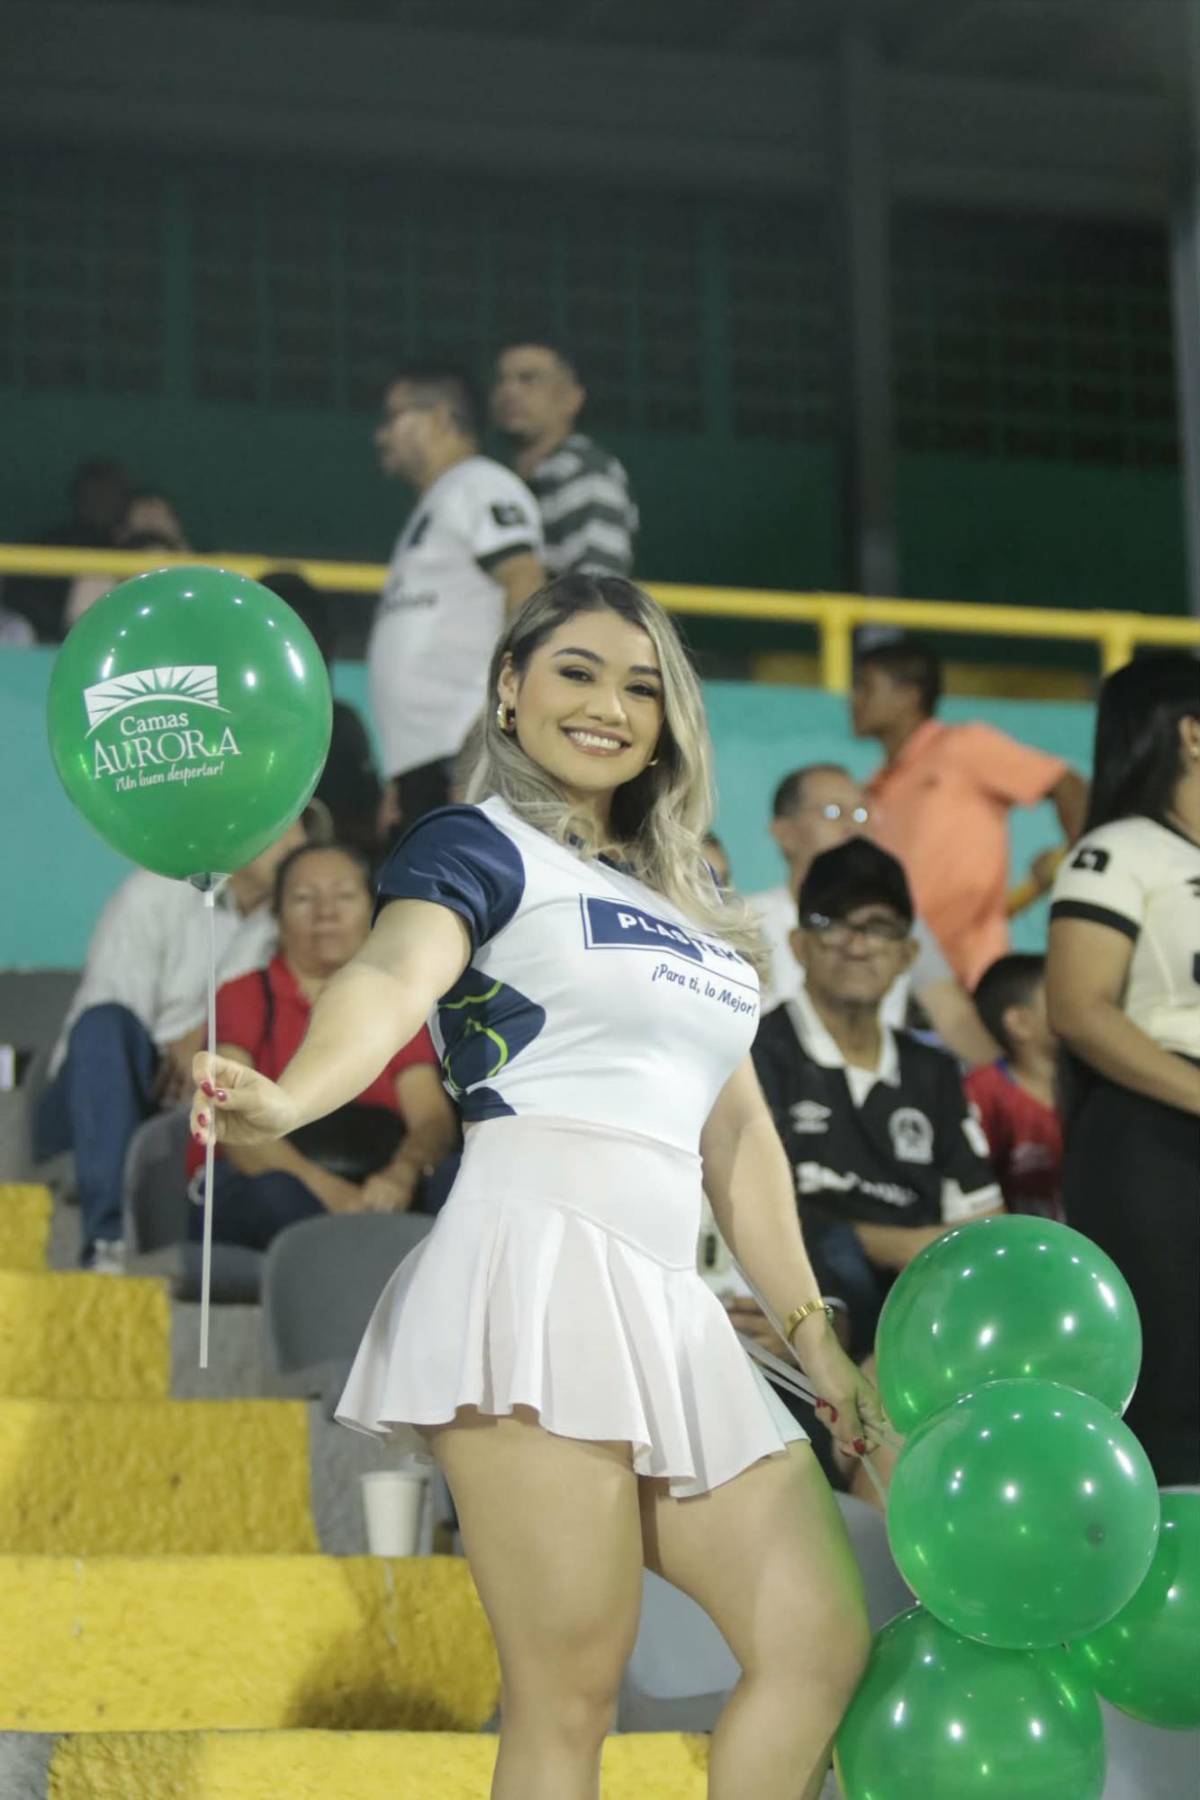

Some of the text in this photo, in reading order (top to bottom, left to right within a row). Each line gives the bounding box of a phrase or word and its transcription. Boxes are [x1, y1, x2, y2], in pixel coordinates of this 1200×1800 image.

[120, 712, 189, 736] Camas
[139, 769, 165, 787] buen
[167, 761, 225, 787] despertar!
[651, 963, 758, 1017] ¡Para ti, lo Mejor!
